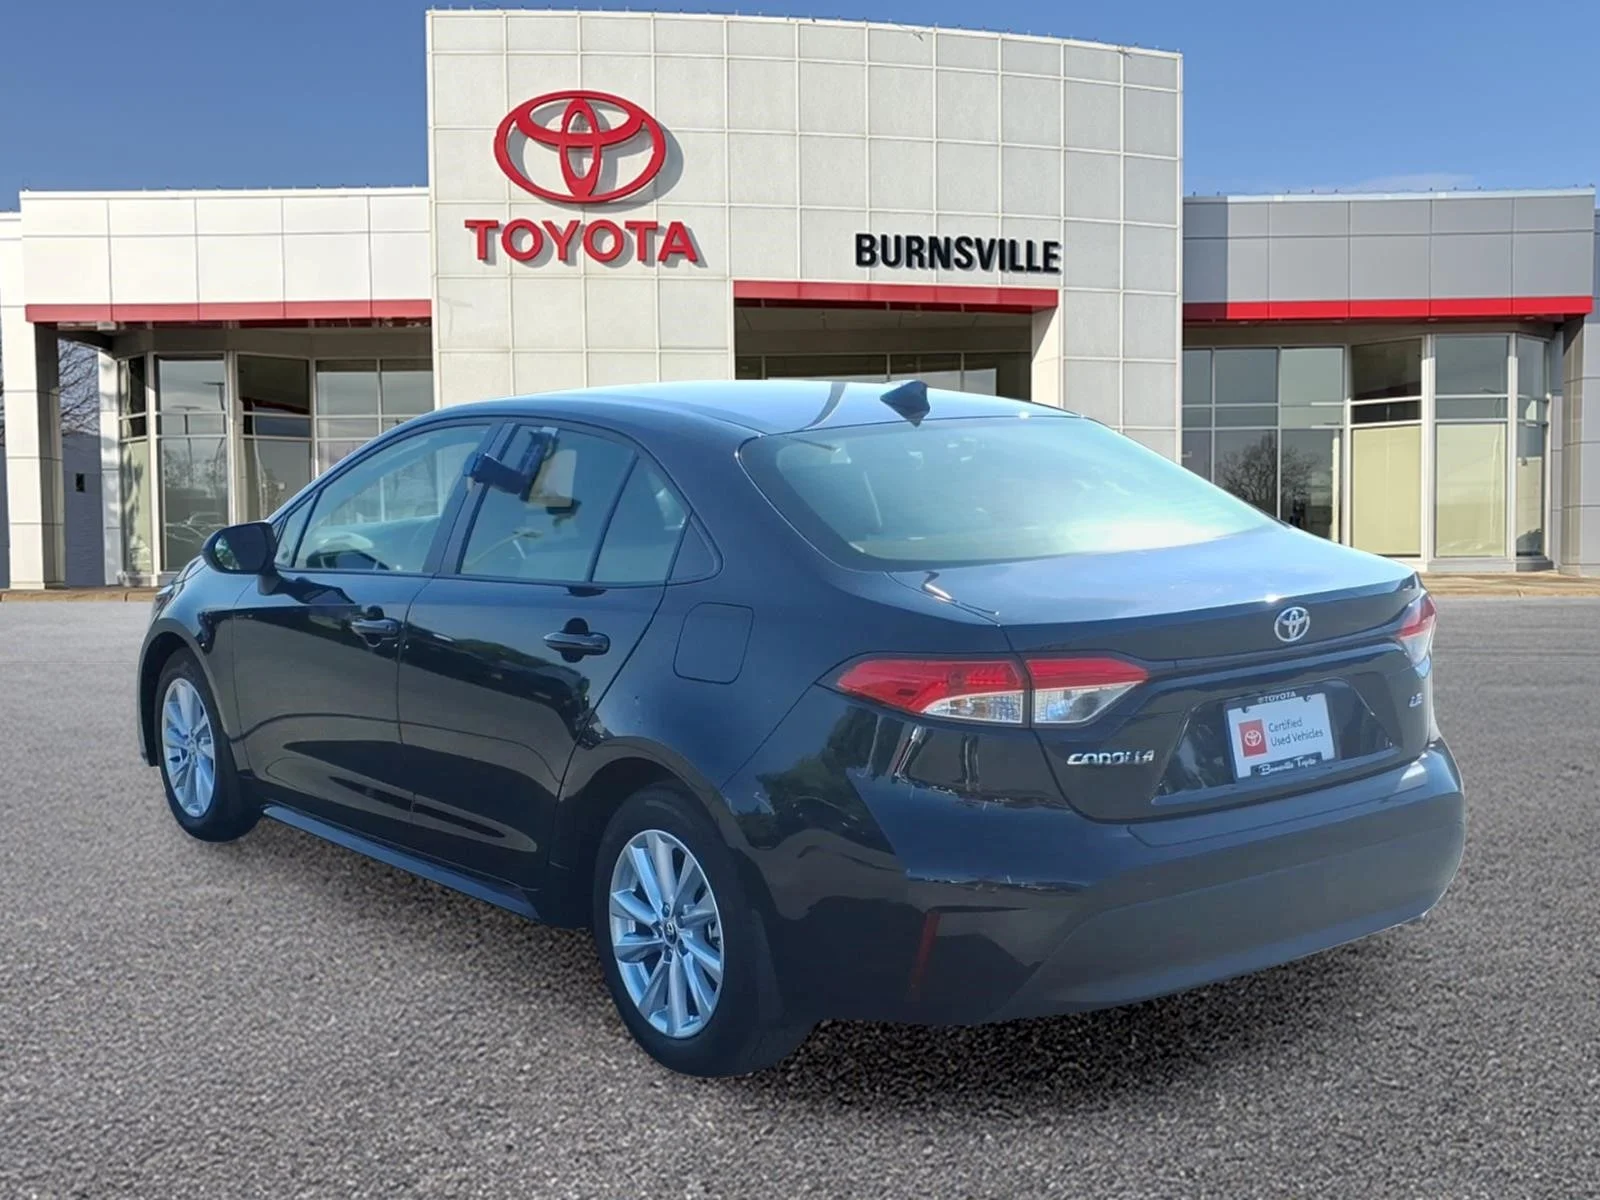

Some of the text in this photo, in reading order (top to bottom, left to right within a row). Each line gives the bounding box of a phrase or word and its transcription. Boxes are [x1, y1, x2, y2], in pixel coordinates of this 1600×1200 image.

[464, 219, 699, 264] TOYOTA
[855, 232, 1061, 272] BURNSVILLE
[1264, 691, 1297, 703] TOYOTA
[1268, 717, 1303, 733] Certified
[1271, 727, 1324, 747] Used Vehicles
